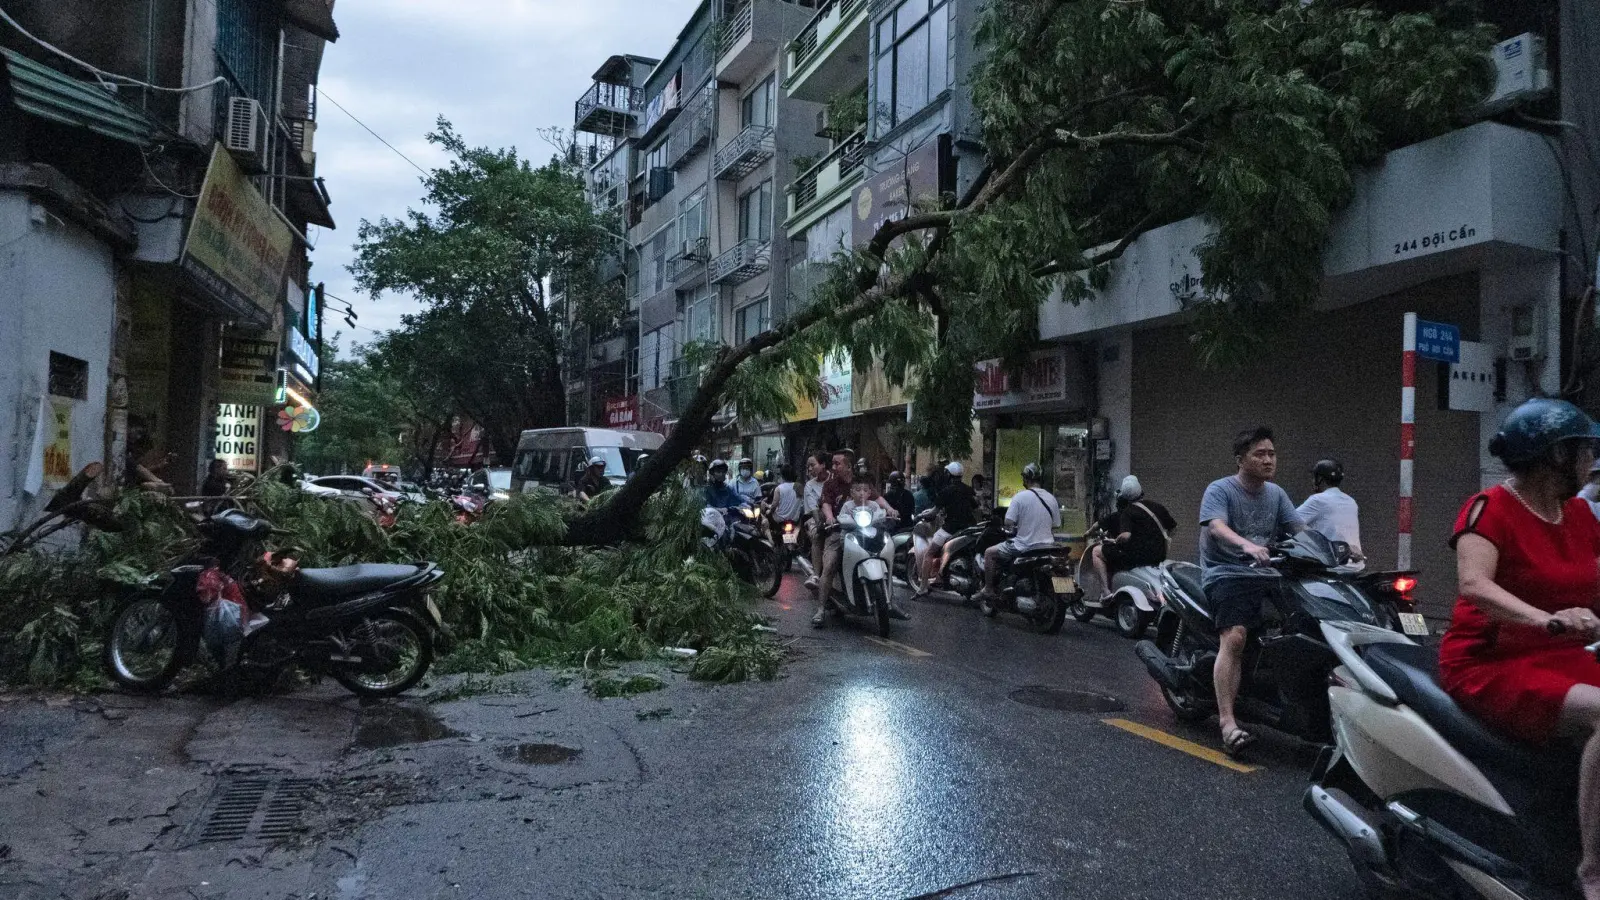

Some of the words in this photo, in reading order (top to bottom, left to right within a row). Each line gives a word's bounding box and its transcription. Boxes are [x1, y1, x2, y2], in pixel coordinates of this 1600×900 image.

[900, 162, 920, 181] GANG
[1394, 239, 1417, 254] 244
[1421, 231, 1445, 248] Đội
[1449, 224, 1476, 241] Cấn
[1440, 330, 1453, 341] 244
